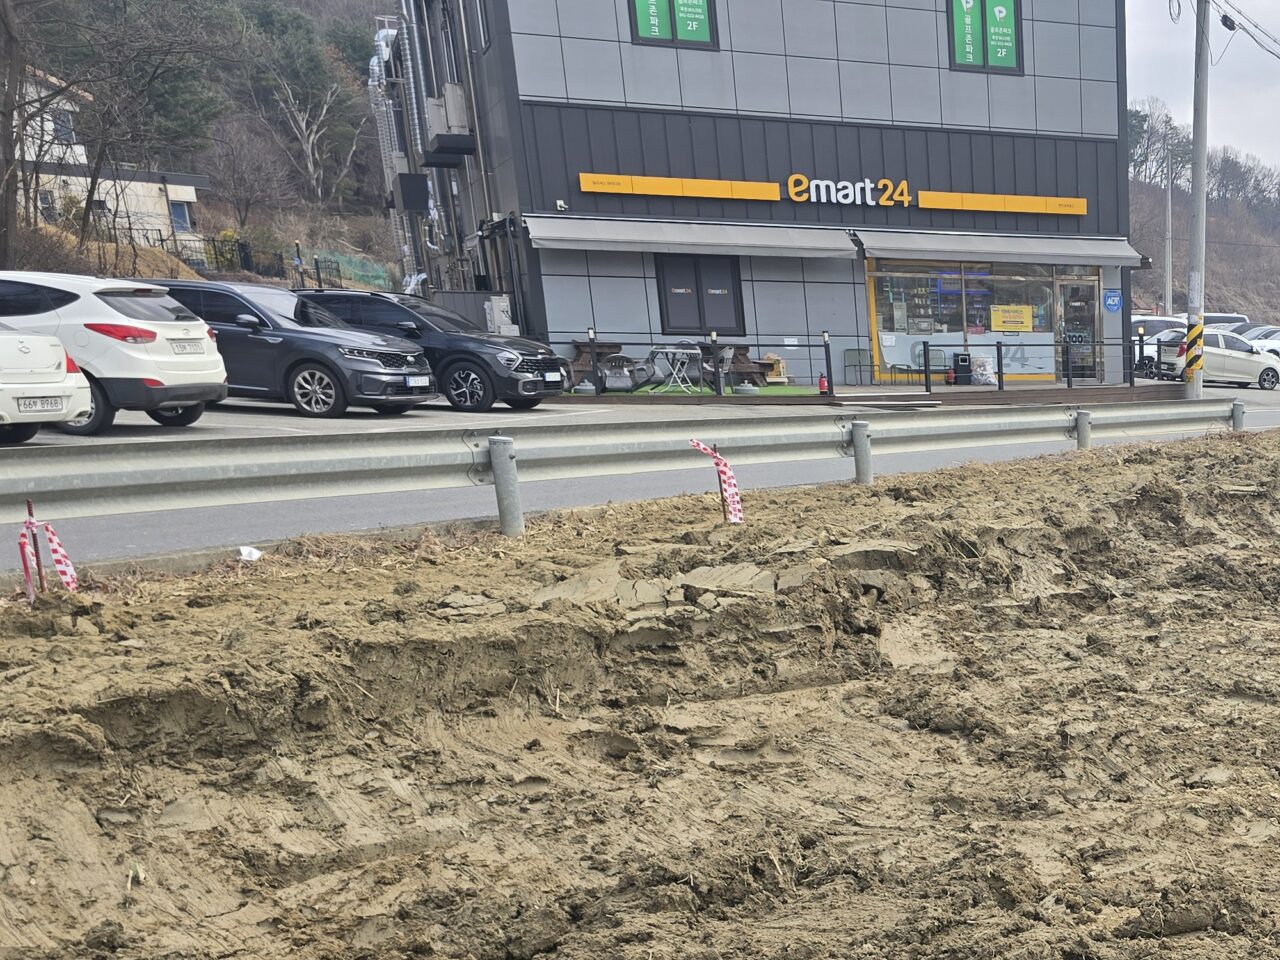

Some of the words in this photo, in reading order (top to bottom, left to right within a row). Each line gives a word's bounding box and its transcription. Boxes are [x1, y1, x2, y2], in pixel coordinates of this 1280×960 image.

[686, 21, 699, 31] 2F
[964, 14, 974, 62] 골프존파크
[996, 48, 1007, 57] 2F
[787, 173, 912, 208] emart24
[1106, 296, 1120, 306] ADT
[40, 396, 60, 409] 8968
